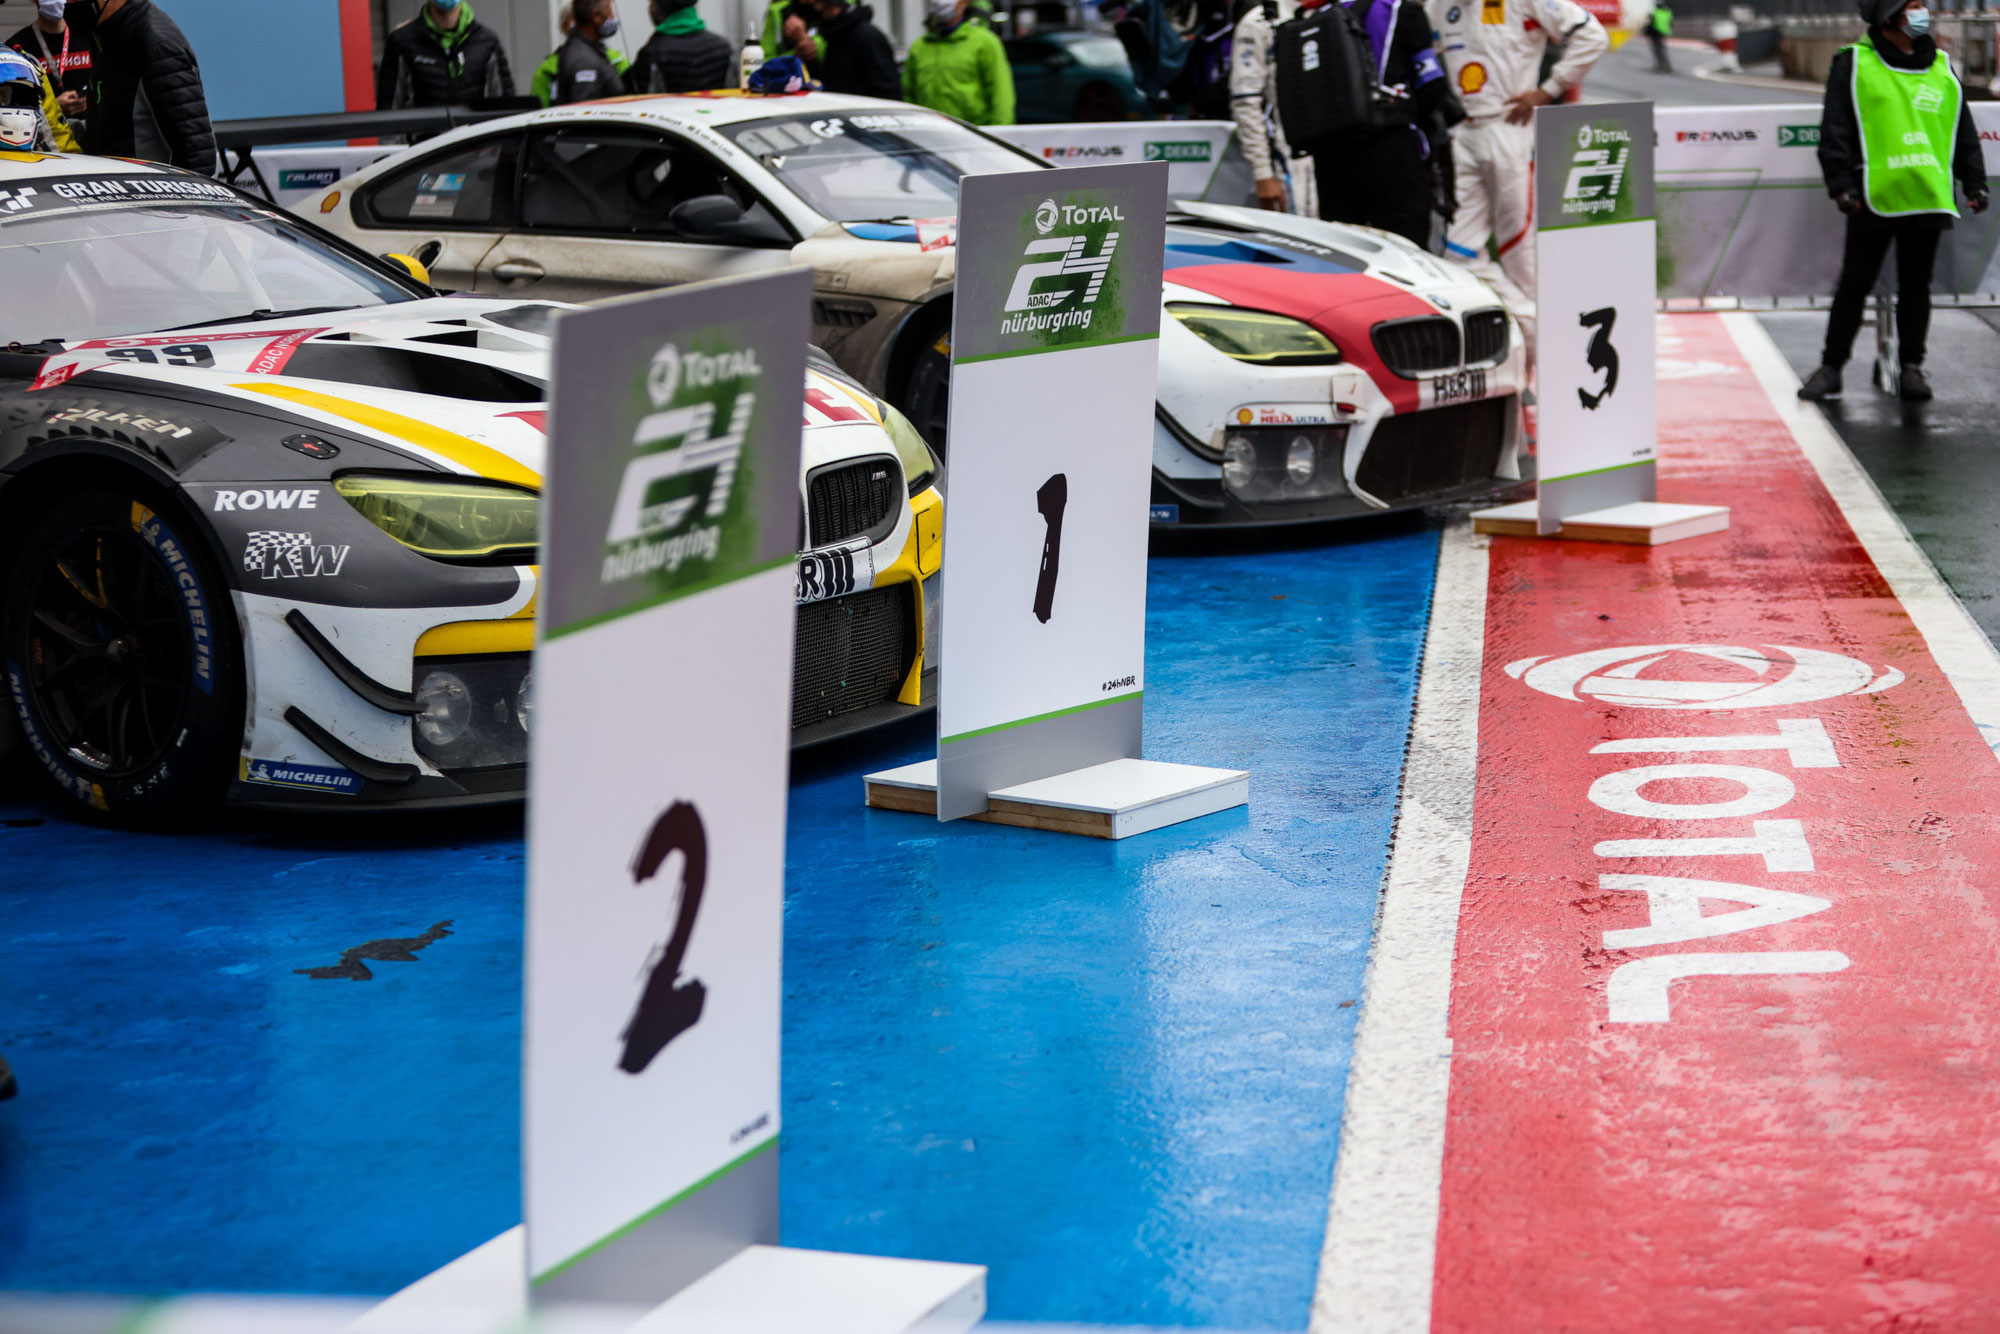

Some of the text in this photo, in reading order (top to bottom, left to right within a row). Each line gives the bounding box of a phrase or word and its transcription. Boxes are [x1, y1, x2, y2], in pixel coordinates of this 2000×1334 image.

[1594, 129, 1631, 143] TOTAL
[1797, 129, 1821, 142] DE
[52, 179, 236, 199] GRAN TURISMO
[69, 197, 97, 205] THE
[98, 194, 130, 203] REAL
[131, 192, 179, 201] DRIVING
[1062, 205, 1125, 226] TOTAL
[1027, 295, 1050, 308] ADAC
[1000, 307, 1093, 335] nürburgring
[104, 344, 216, 369] 99
[255, 349, 284, 375] ADAC
[682, 348, 763, 386] TOTAL
[1578, 306, 1620, 412] 3
[213, 489, 321, 512] ROWE
[261, 544, 351, 580] KW
[1033, 473, 1067, 625] 1
[160, 538, 210, 680] MICHELIN
[9, 672, 73, 789] MICHELIN
[272, 769, 353, 787] MICHELIN
[1588, 718, 1851, 1023] TOTAL
[617, 798, 708, 1075] 2
